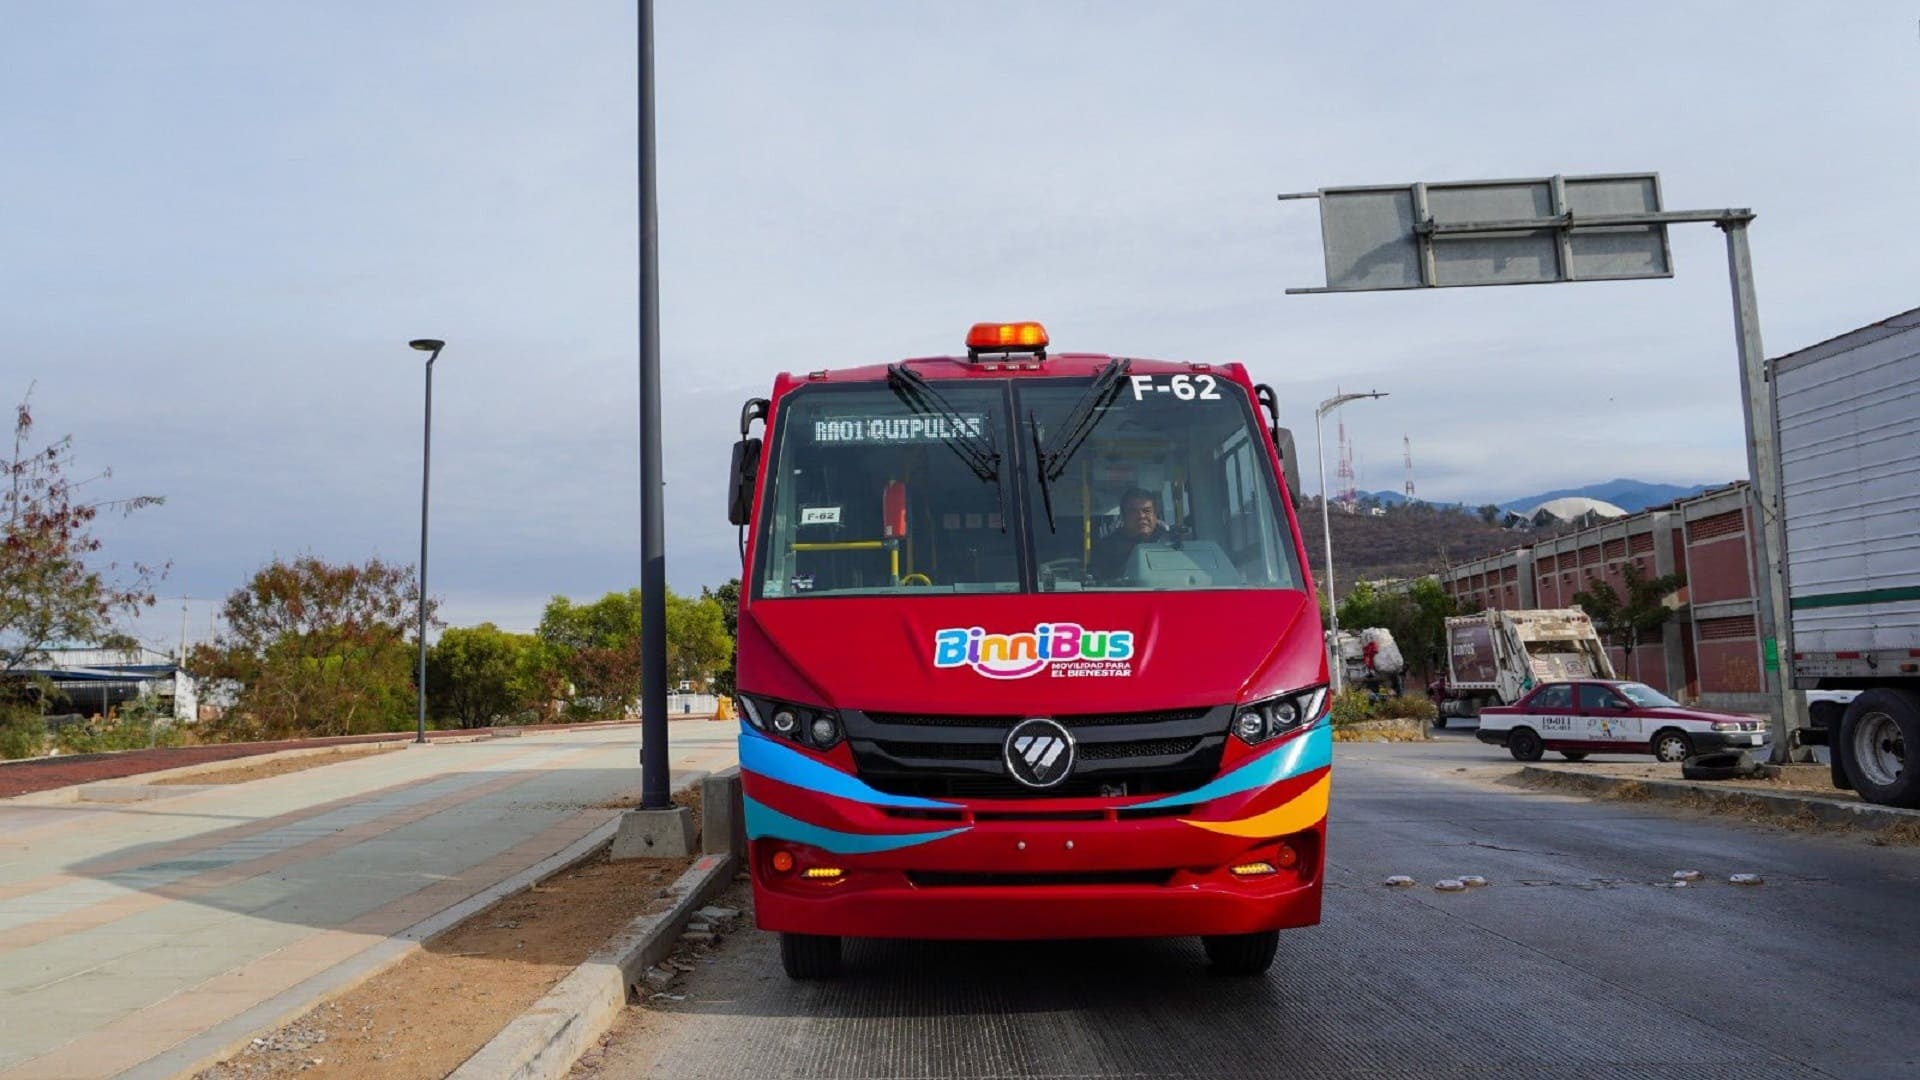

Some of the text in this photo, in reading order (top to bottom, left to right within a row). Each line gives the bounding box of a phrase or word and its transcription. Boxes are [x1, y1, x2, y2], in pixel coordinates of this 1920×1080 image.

[1130, 375, 1222, 401] F-62
[815, 418, 980, 441] RA01 QUIPULAS
[808, 512, 835, 521] F-62
[936, 623, 1133, 667] BinniBus
[1051, 662, 1104, 670] MOVILIDAD
[1051, 669, 1132, 678] EL BIENESTAR
